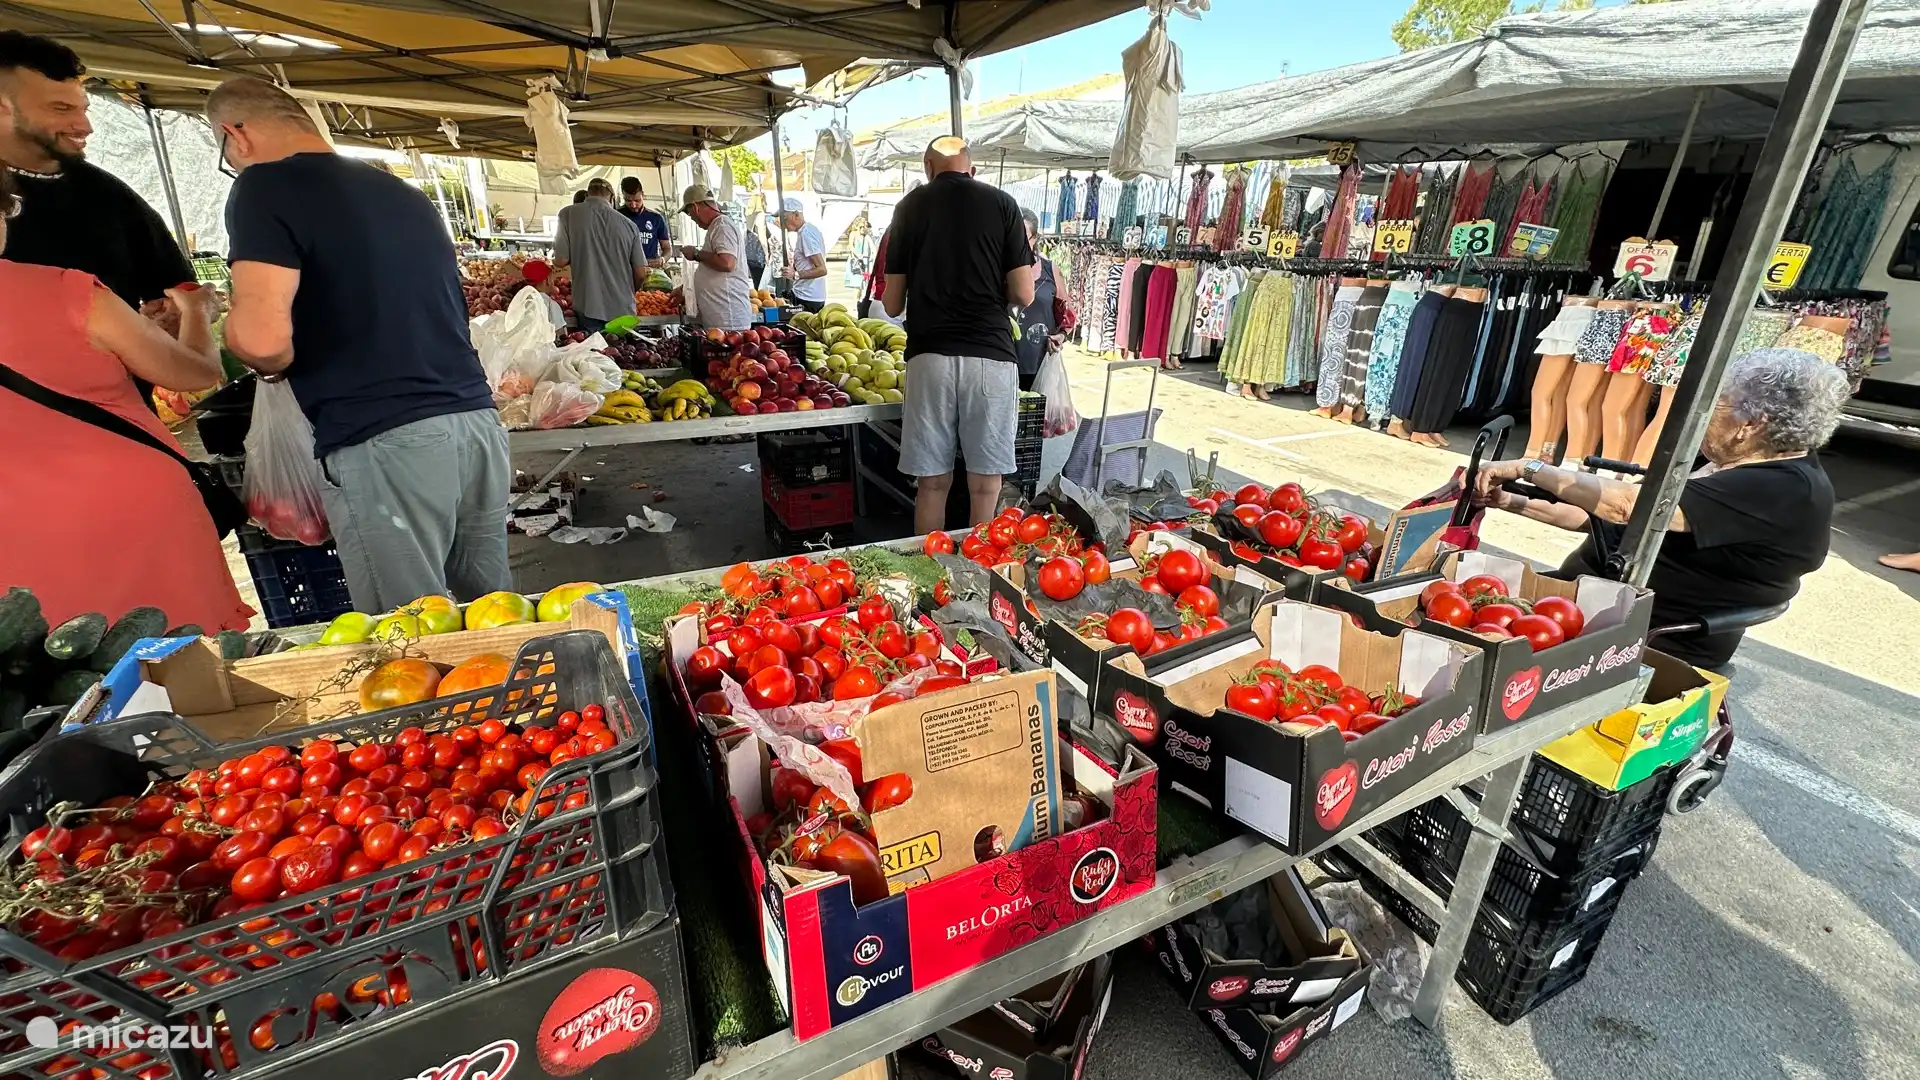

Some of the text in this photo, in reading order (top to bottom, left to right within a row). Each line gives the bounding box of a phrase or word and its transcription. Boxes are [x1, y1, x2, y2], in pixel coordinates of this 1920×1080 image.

[1331, 147, 1351, 161] 15
[1248, 231, 1263, 246] 5
[1271, 232, 1297, 240] OFERTA
[1466, 226, 1490, 253] 8
[1627, 246, 1669, 257] OFERTA
[1775, 248, 1805, 257] FERTA
[1542, 637, 1643, 693] Cuori Rossi
[923, 711, 950, 723] GROWN
[950, 708, 964, 717] AND
[965, 702, 988, 713] PACKED
[1116, 697, 1149, 720] Cherry
[1028, 704, 1046, 796] Bananas
[1164, 720, 1212, 752] Cuori
[1361, 705, 1474, 790] Cuori Rossi
[1165, 738, 1212, 772] Rossi
[1316, 775, 1348, 806] Cherry
[880, 841, 935, 872] RITA
[1080, 857, 1113, 883] Ruby
[1084, 870, 1108, 893] Red
[945, 895, 1033, 941] BELORTA
[847, 964, 905, 998] Flavour
[578, 1001, 654, 1052] Cherry
